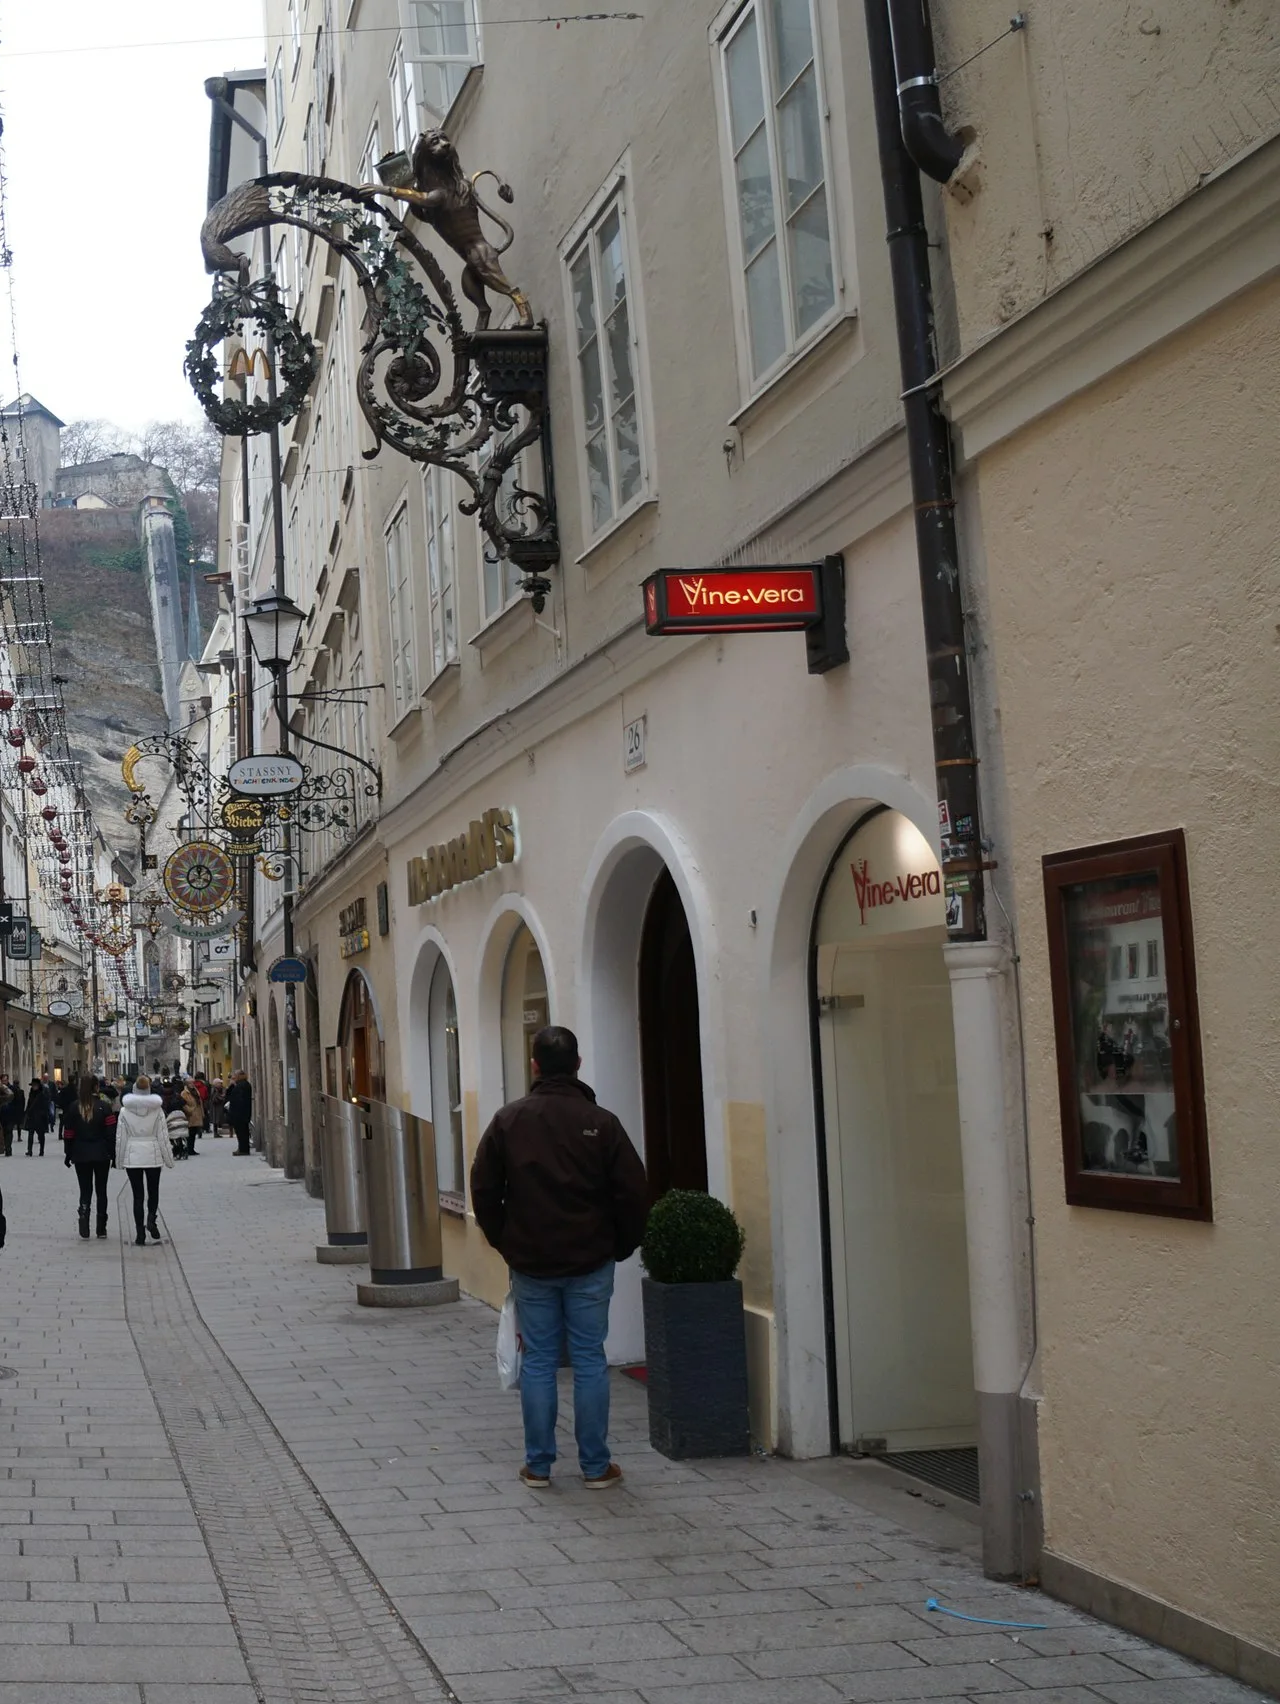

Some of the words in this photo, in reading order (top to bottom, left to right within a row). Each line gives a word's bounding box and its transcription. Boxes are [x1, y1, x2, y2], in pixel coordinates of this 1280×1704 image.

[629, 723, 640, 754] 26
[240, 766, 292, 777] STASSNY
[233, 777, 298, 785] TRACHTENKNDER
[225, 815, 263, 828] Wieber
